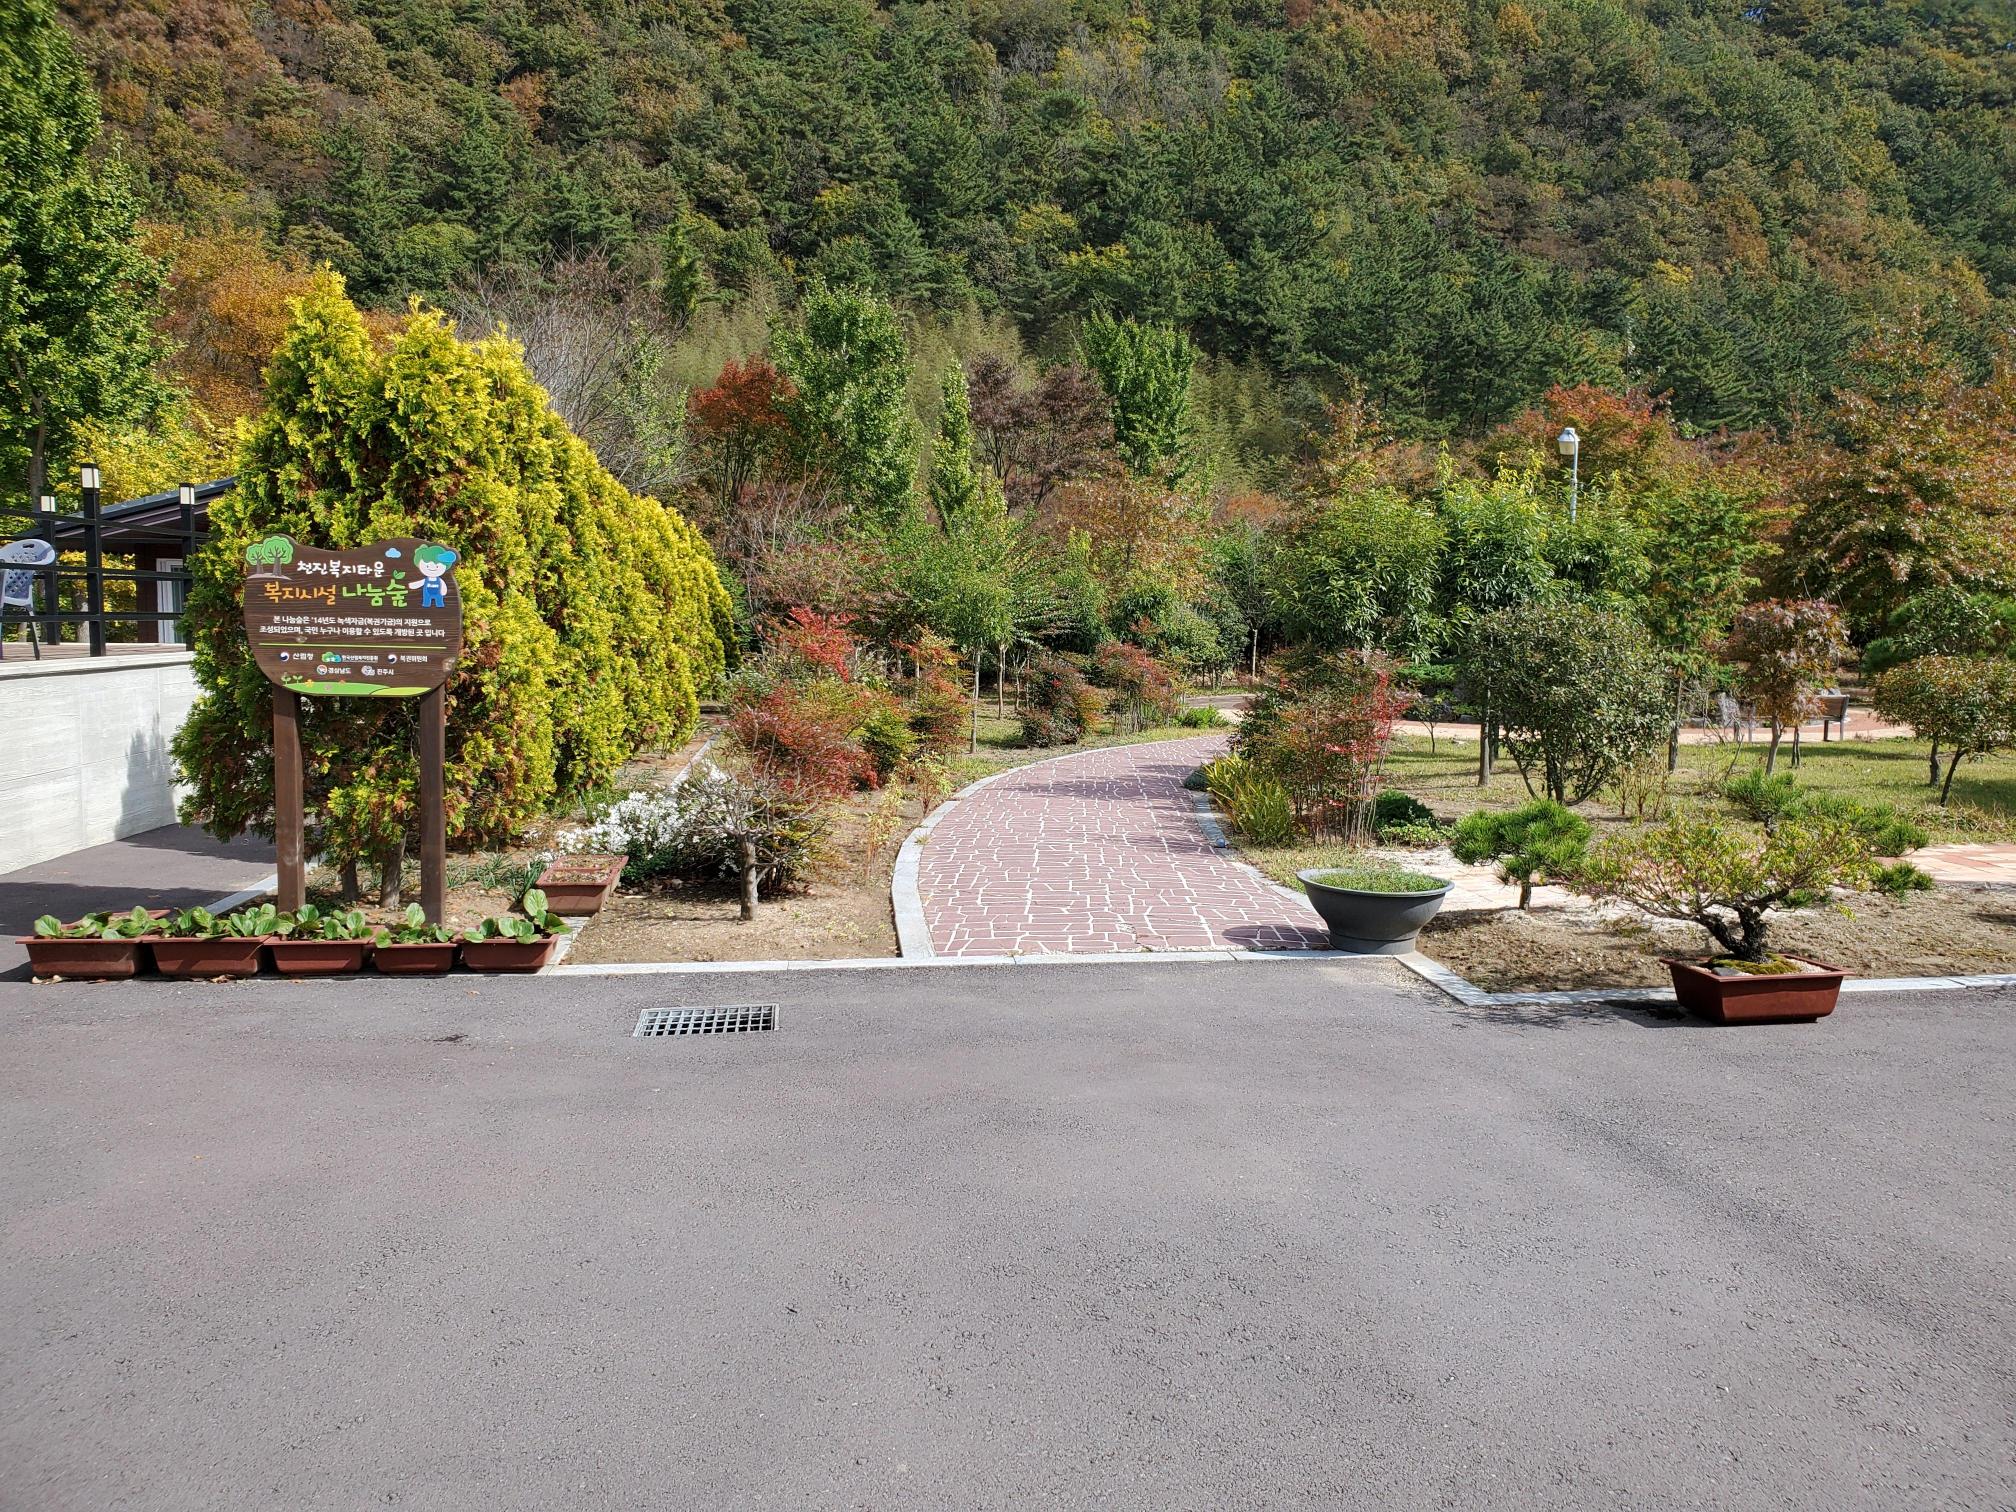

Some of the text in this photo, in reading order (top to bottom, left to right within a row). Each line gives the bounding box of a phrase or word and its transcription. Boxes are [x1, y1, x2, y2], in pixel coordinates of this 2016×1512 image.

[264, 579, 409, 607] 복지시설 나눔숲
[273, 616, 281, 624] 본
[282, 616, 310, 624] 나눔숲은
[337, 617, 402, 626] 녹색자금(복권기금)의
[404, 618, 432, 626] 지원으로
[260, 626, 304, 634] 조성되었으며,
[304, 626, 318, 634] 국민
[320, 626, 341, 635] 누구나
[342, 626, 363, 636] 이용할
[364, 628, 372, 636] 수
[416, 628, 424, 636] 곳
[424, 628, 446, 638] 입니다
[292, 652, 314, 660] 산림청
